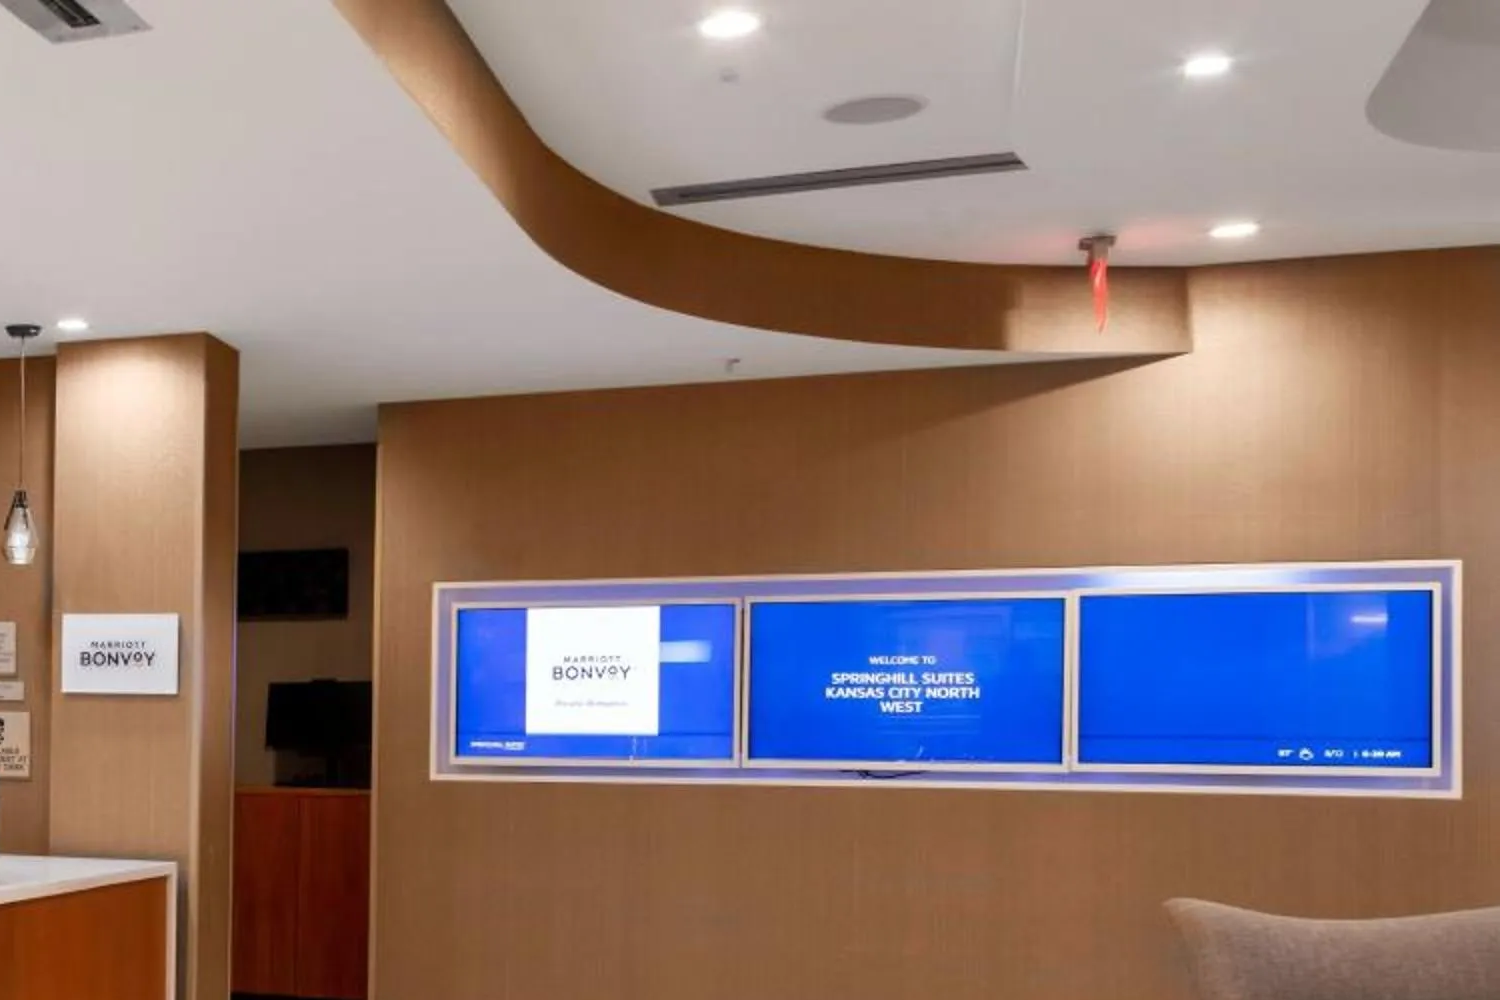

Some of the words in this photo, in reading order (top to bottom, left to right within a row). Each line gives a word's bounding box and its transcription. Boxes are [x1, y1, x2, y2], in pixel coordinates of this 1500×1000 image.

[90, 641, 145, 649] MARRIOTT
[79, 651, 155, 667] BONVOY
[869, 655, 918, 664] WELCOME
[922, 655, 937, 664] TO
[552, 665, 631, 680] BONVOY
[831, 672, 918, 685] SPRINGHILL
[921, 672, 975, 685] SUITES
[825, 687, 884, 698] KANSAS
[888, 687, 921, 698] CITY
[925, 687, 980, 698] NORTH
[879, 701, 923, 713] WEST
